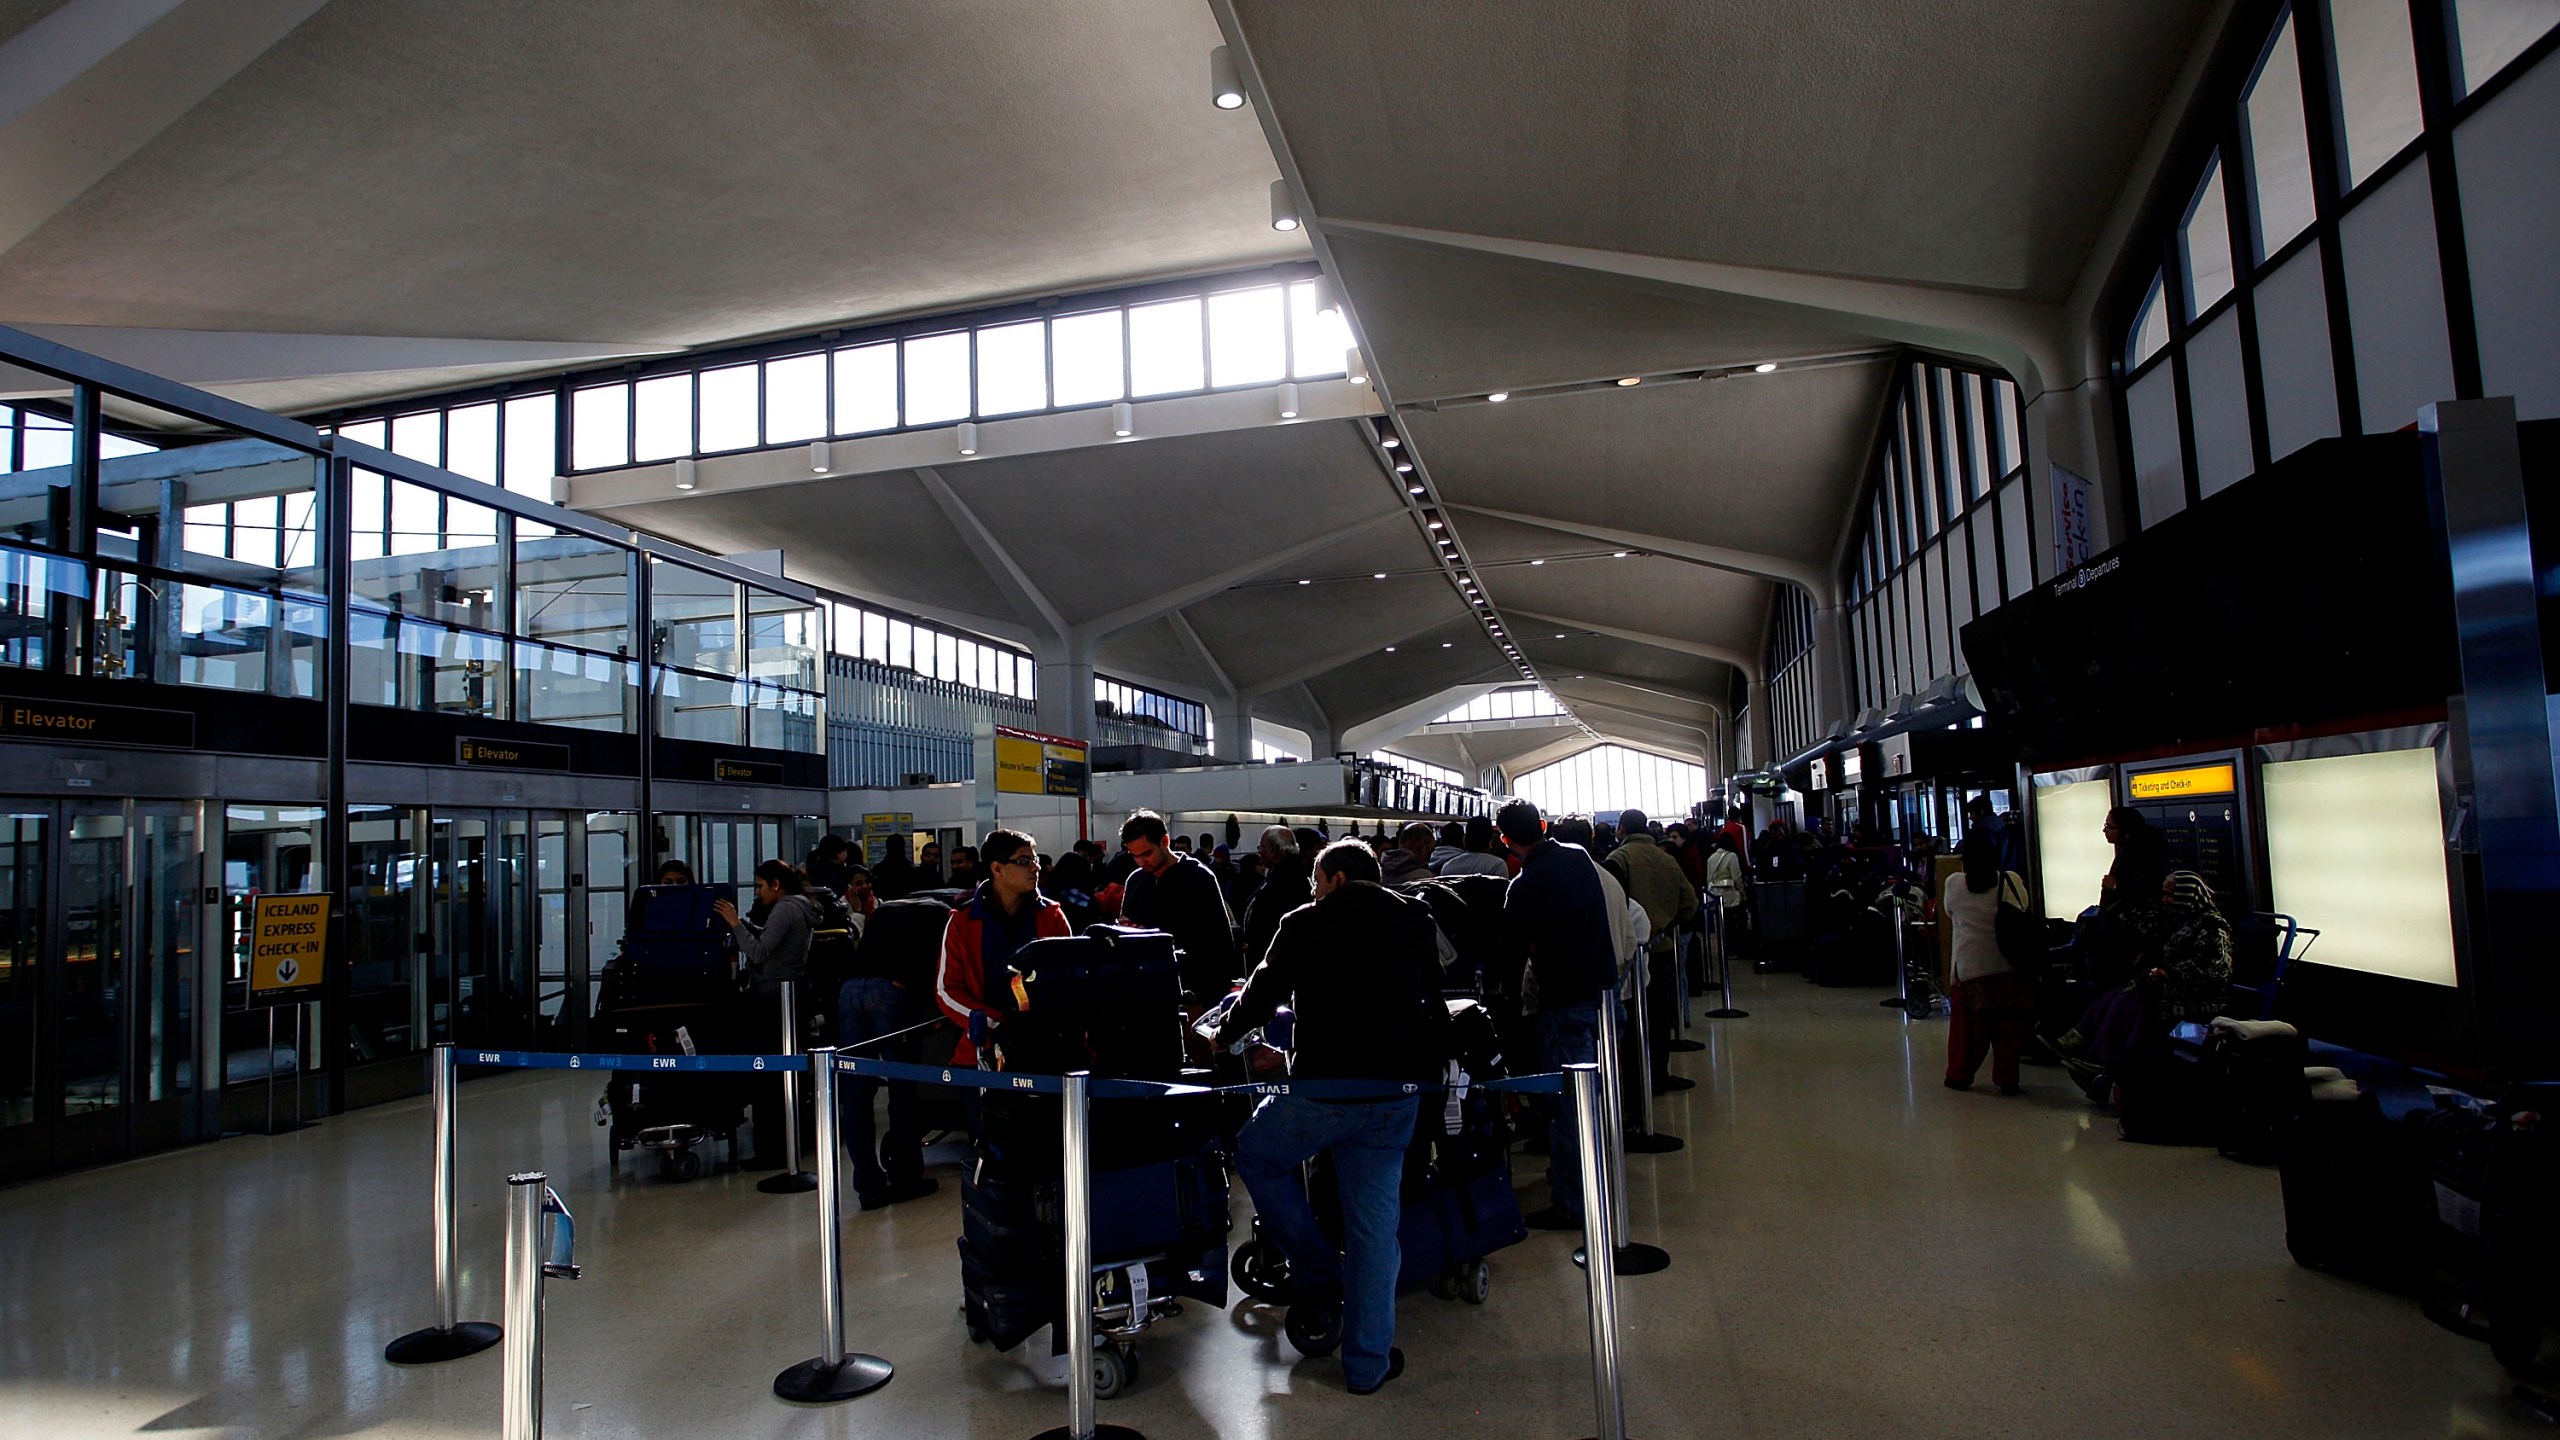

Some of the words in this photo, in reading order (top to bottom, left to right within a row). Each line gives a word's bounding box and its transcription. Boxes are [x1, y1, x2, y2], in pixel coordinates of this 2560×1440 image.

[2063, 482, 2074, 570] service
[2054, 575, 2078, 597] Terminal
[2086, 557, 2120, 581] Departures
[13, 709, 96, 730] Elevator
[477, 746, 519, 760] Elevator
[727, 766, 753, 777] Elevator
[2139, 782, 2160, 793] Ticketing
[2160, 780, 2170, 791] and
[2170, 778, 2192, 790] Check-in
[265, 903, 319, 917] ICELAND
[264, 922, 317, 937] EXPRESS
[258, 941, 320, 957] CHECK-IN
[479, 1053, 501, 1063] EWR
[653, 1058, 677, 1068] EWR
[838, 1060, 856, 1071] EWR
[1013, 1077, 1034, 1089] EWR
[1256, 1084, 1290, 1095] EWR
